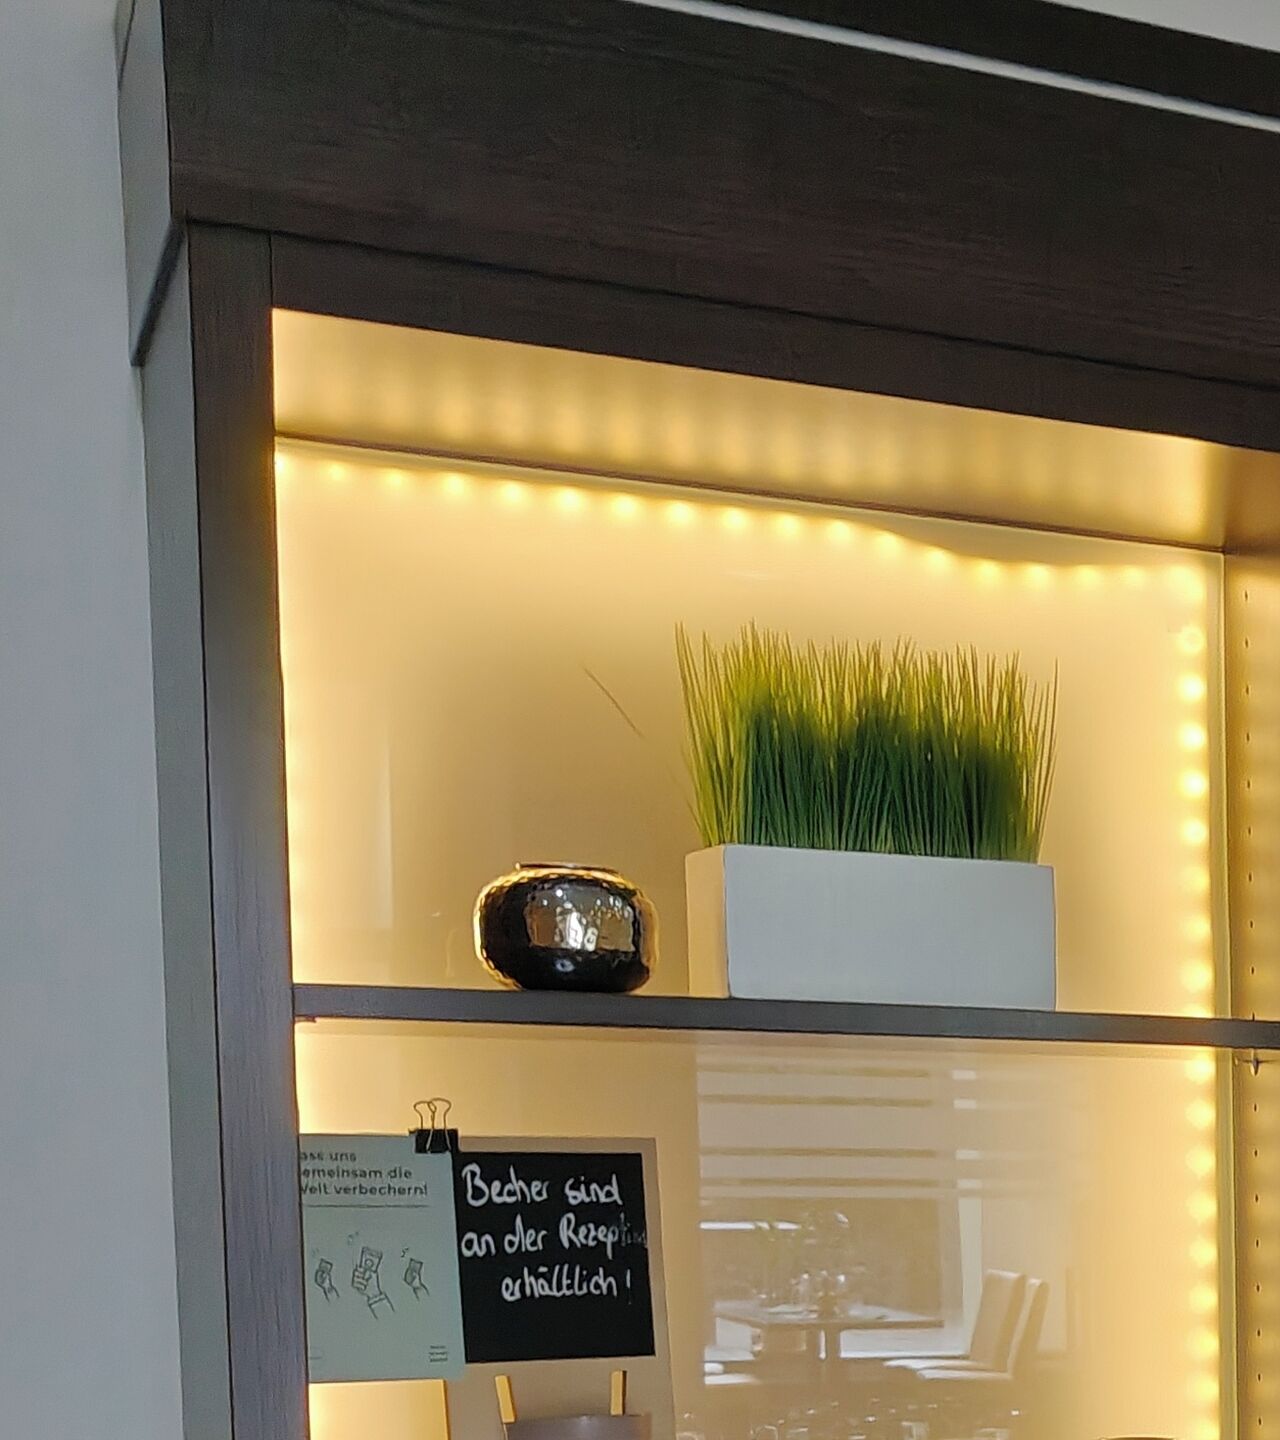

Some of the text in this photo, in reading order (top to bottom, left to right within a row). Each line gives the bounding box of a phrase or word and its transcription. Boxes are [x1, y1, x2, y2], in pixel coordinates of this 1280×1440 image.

[329, 1152, 357, 1162] uns
[302, 1165, 412, 1179] emeinsam die
[334, 1182, 428, 1196] verbechern!
[461, 1163, 623, 1207] Becher sind
[461, 1231, 496, 1257] an
[504, 1213, 548, 1254] der
